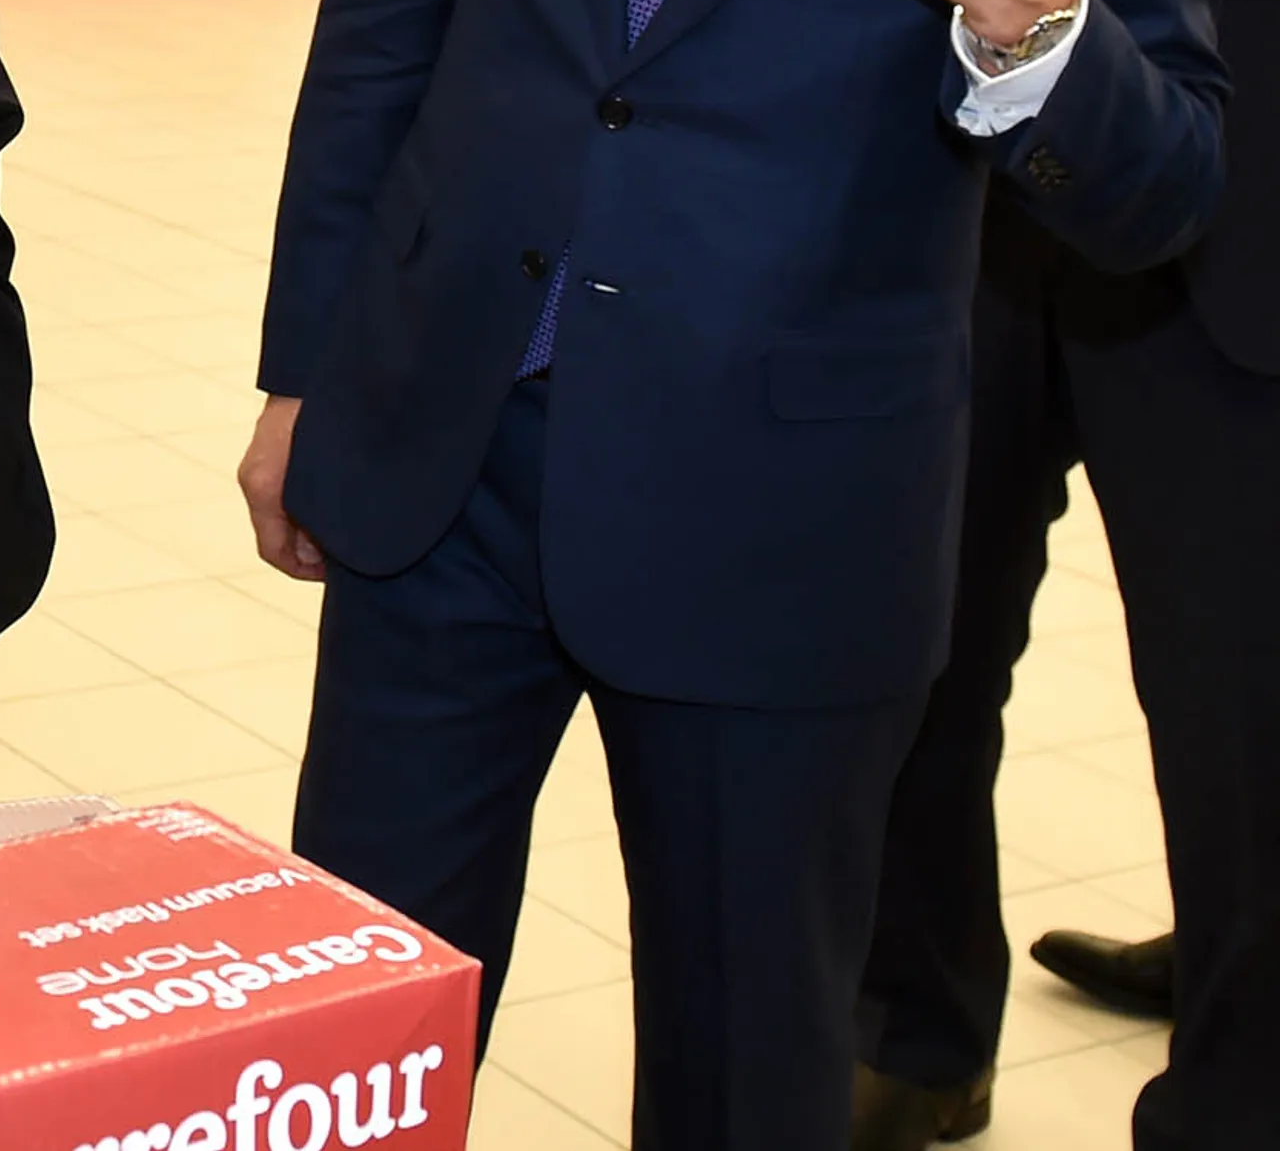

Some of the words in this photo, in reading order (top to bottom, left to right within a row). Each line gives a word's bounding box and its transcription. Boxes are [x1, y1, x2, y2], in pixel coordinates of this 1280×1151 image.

[163, 867, 312, 913] Vacuum
[17, 921, 83, 949] set
[77, 900, 171, 934] flask
[36, 938, 243, 996] home
[78, 924, 423, 1030] Carrefour
